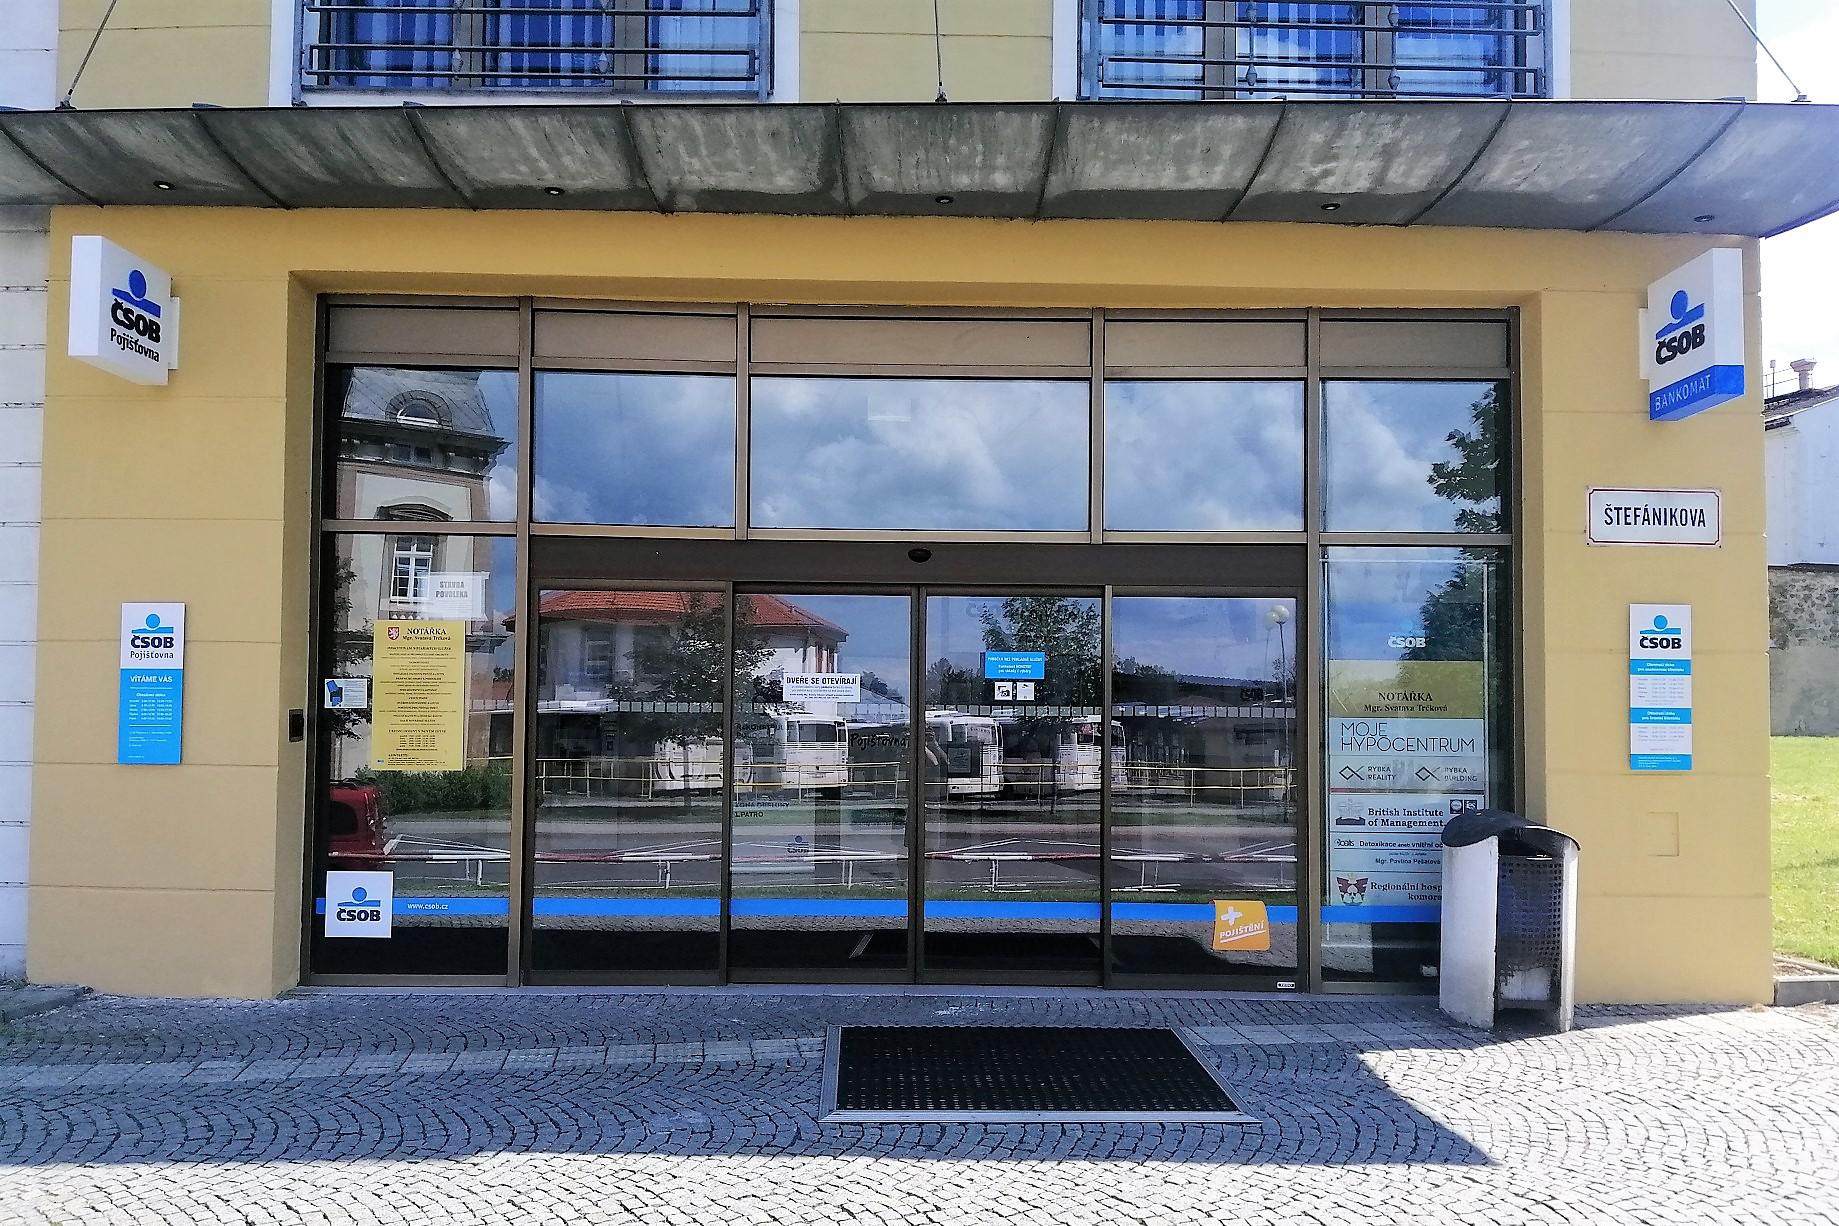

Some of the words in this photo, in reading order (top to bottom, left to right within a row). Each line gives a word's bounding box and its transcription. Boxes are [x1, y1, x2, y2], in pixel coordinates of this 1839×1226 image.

[111, 298, 161, 343] ČSOB
[110, 328, 160, 363] Pojišťovna
[1655, 323, 1705, 365] ČSOB
[1655, 375, 1711, 411] BANKOMAT
[1604, 504, 1706, 527] ŠTEFÁNIKOVA
[407, 627, 447, 635] NOTÁŘKA
[130, 634, 175, 649] ČSOB
[1387, 635, 1426, 648] ČSOB
[1639, 635, 1682, 649] ČSOB
[130, 650, 174, 660] Pojišťovna
[130, 675, 157, 683] VÍTÁME
[158, 675, 173, 683] VÁS
[786, 675, 809, 684] DVEŘE
[822, 676, 858, 685] OTEVÍRAJÍ
[1378, 691, 1433, 701] NOTÁŘKA
[1364, 704, 1382, 713] Mgr.
[1385, 704, 1415, 712] Svatava
[1417, 703, 1448, 712] Trčková
[1341, 722, 1388, 737] MOJE
[1341, 737, 1475, 753] HYPOCENTRUM
[1368, 808, 1400, 816] British
[1403, 808, 1444, 817] Institute
[1368, 818, 1378, 827] of
[1370, 882, 1419, 891] Regionální
[336, 908, 381, 922] ČSOB
[1220, 920, 1265, 938] POJIŠTĚNÍ
